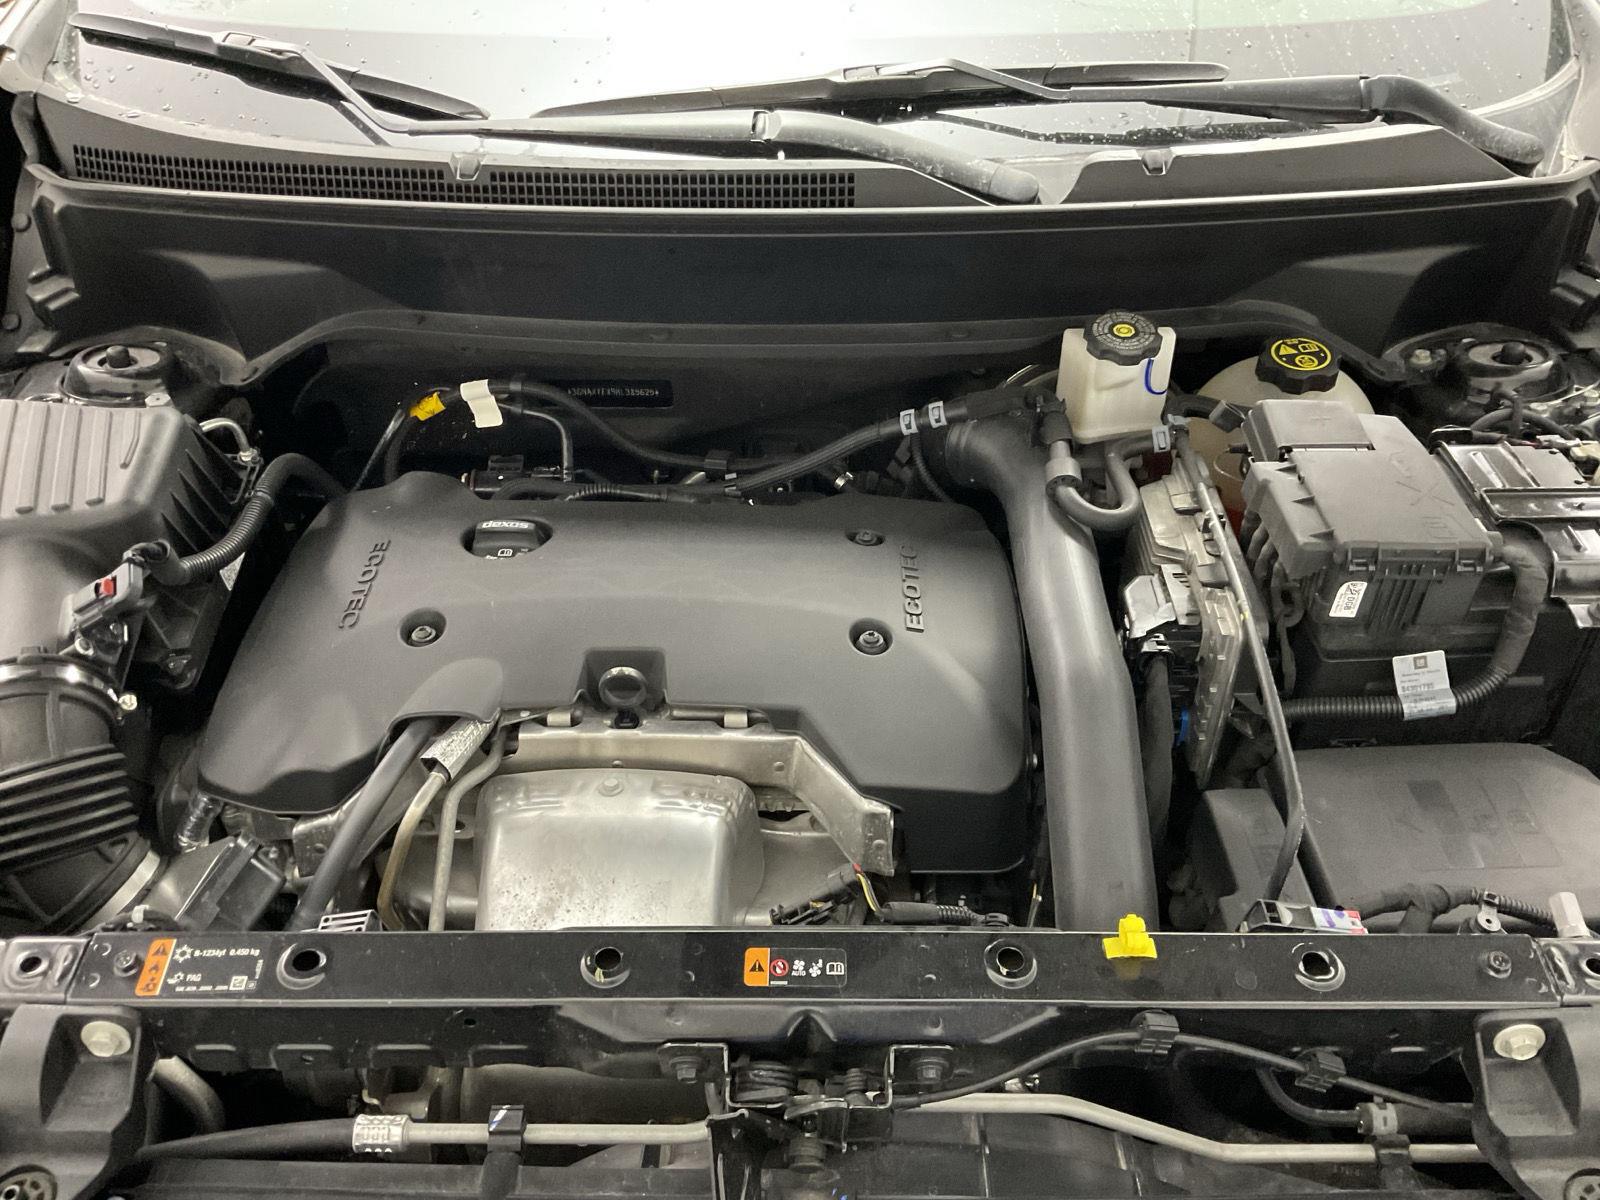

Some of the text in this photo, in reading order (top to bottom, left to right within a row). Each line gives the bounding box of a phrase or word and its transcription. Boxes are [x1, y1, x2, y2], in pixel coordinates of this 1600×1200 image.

[482, 520, 529, 529] dexos
[338, 540, 391, 630] ECOTEC
[900, 545, 925, 634] ECOTEC
[250, 948, 260, 957] kg
